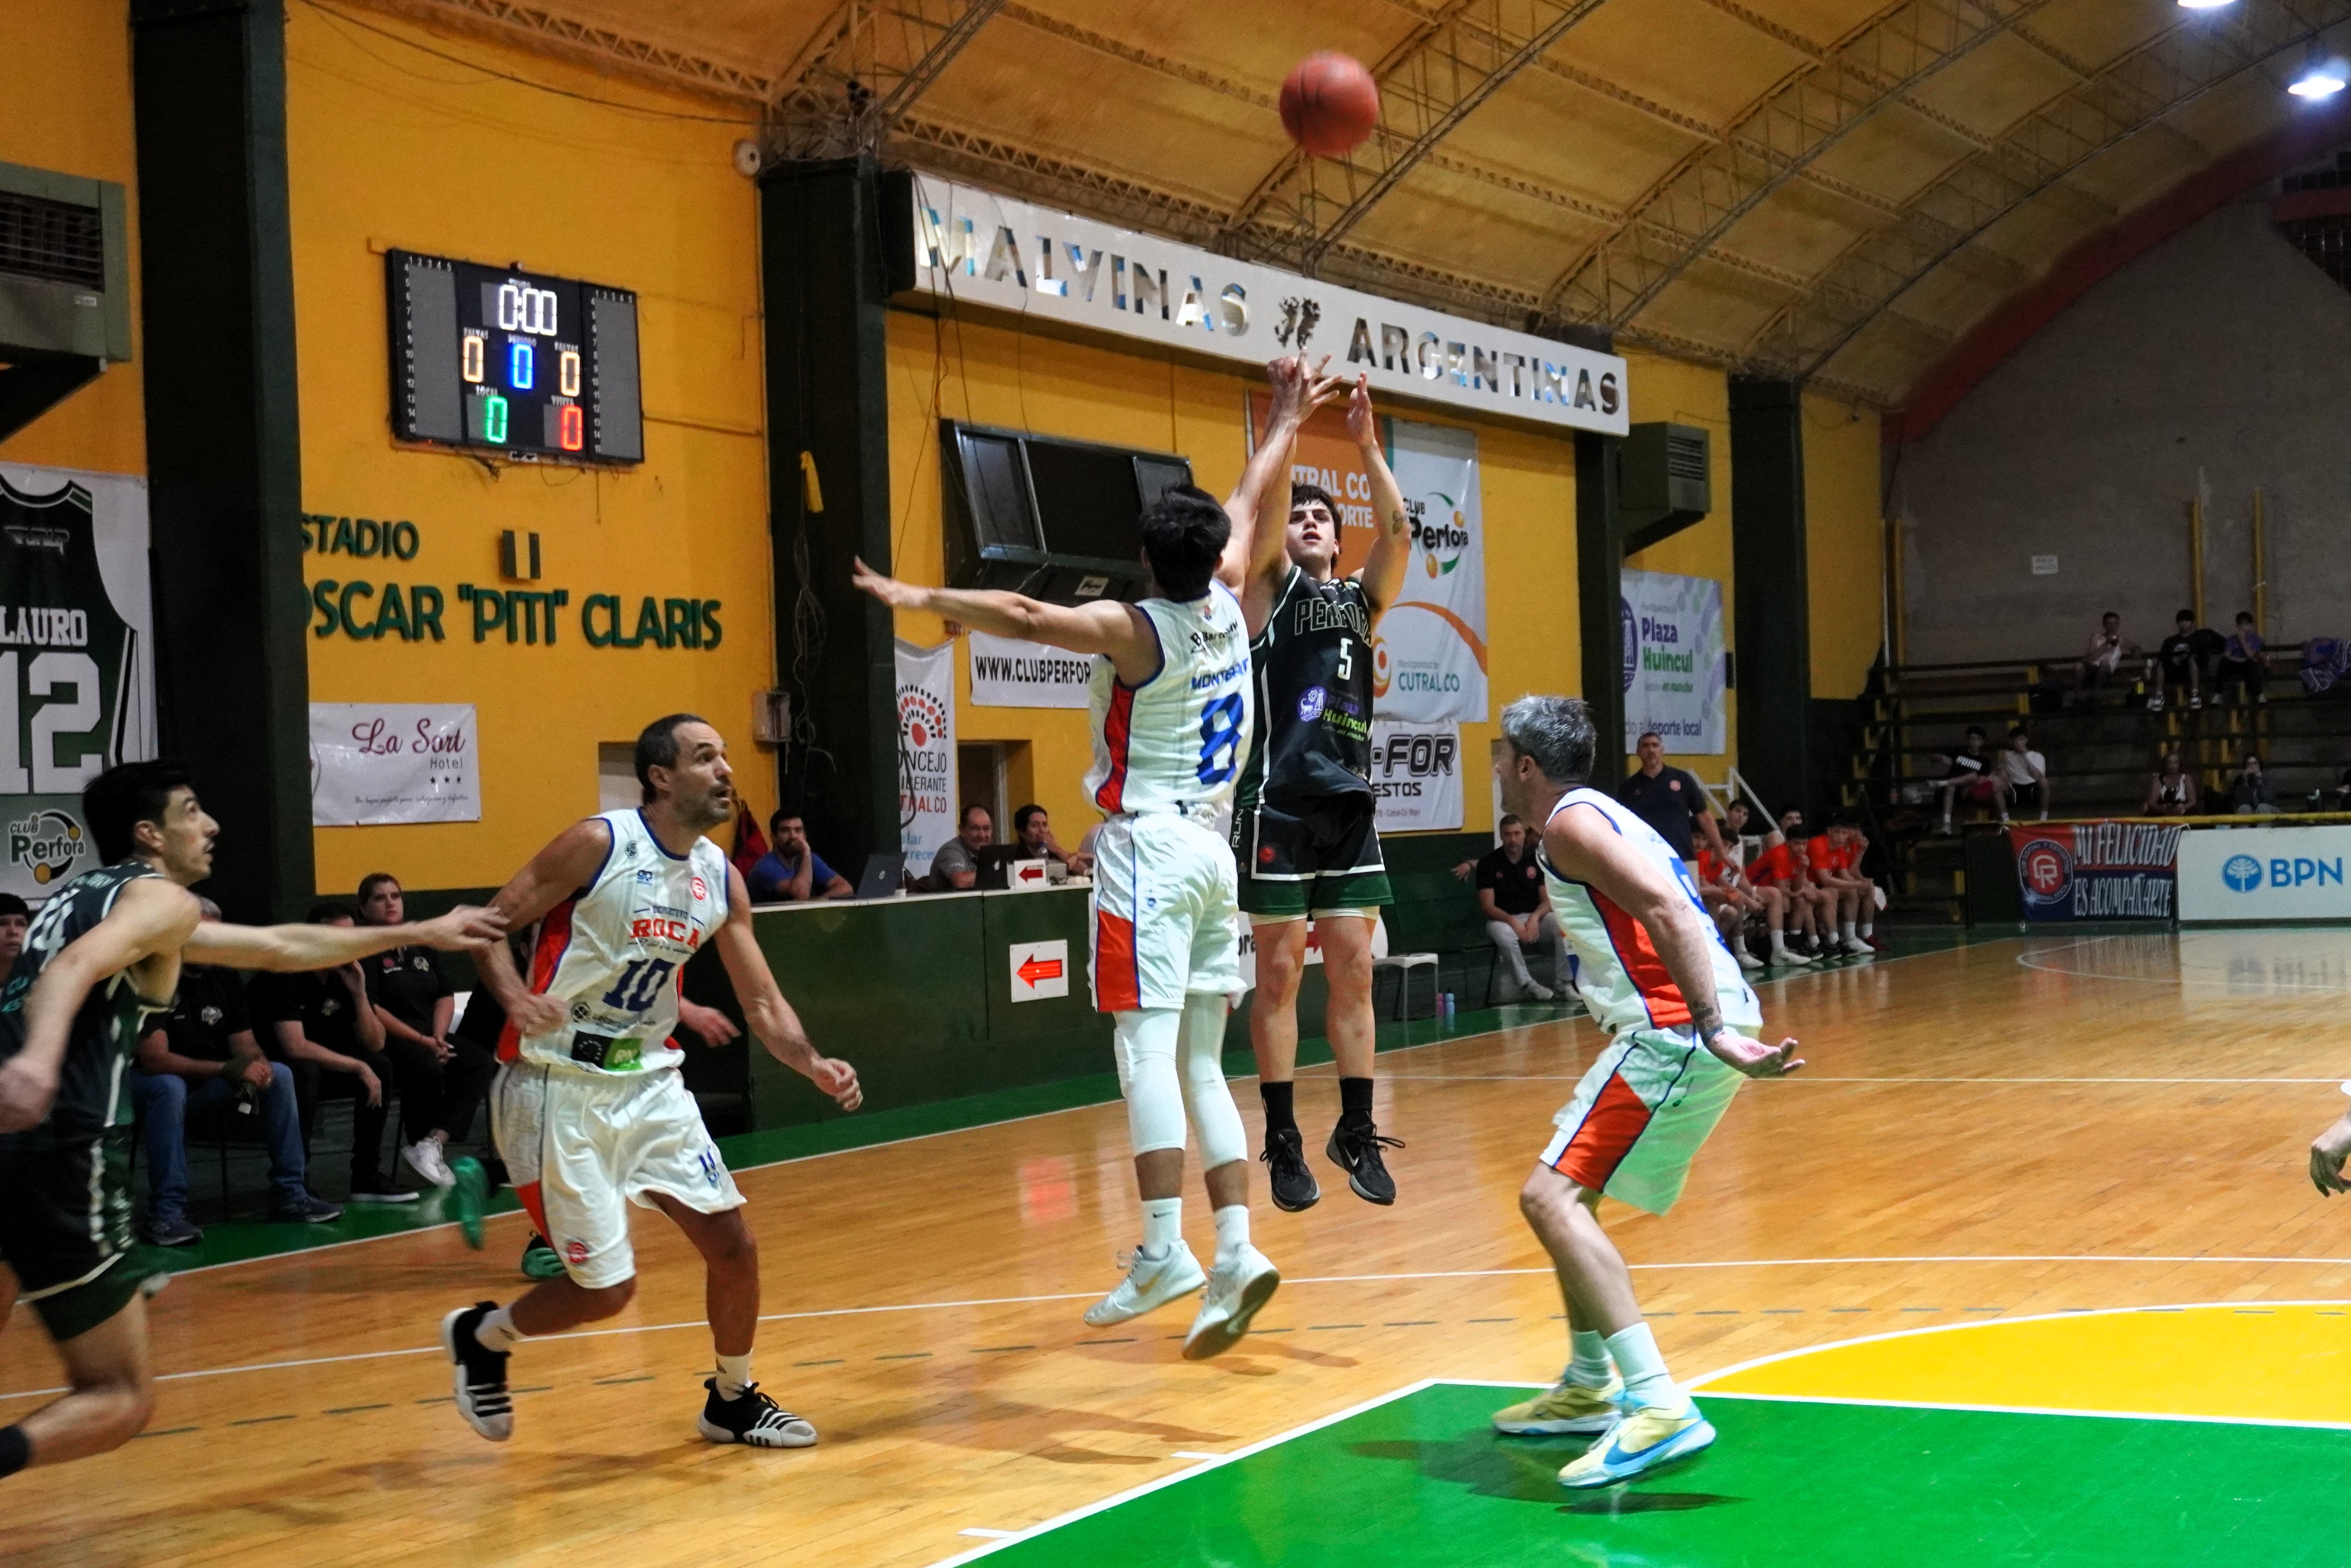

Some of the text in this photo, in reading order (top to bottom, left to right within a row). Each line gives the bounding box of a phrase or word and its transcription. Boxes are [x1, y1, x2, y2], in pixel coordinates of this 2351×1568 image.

[499, 284, 557, 336] 0:00
[919, 206, 1620, 415] MALVINAS ARGENTINAS
[463, 336, 533, 389] 0 0
[561, 351, 580, 397] 0
[487, 396, 507, 443] 0
[561, 405, 583, 451] 0
[0, 605, 88, 646] LAURO
[582, 594, 722, 650] CLARIS
[1642, 616, 1678, 643] Plaza
[1337, 637, 1353, 681] 5
[1642, 644, 1693, 673] Huincul
[1398, 672, 1461, 692] CUTRAL CO
[0, 651, 103, 794] 12
[352, 718, 403, 755] La
[1196, 693, 1244, 785] 8
[1323, 708, 1367, 734] Huincul
[1683, 718, 1702, 736] local
[430, 757, 463, 770] Hotel
[934, 796, 947, 813] CO
[11, 823, 39, 834] CLUB
[11, 835, 85, 863] Perfora
[2095, 824, 2181, 867] FELICIDAD
[2271, 857, 2344, 888] BPN
[2073, 873, 2173, 917] ES ACOMPAÑARTE
[630, 918, 700, 950] ROCA
[602, 958, 675, 1011] 10
